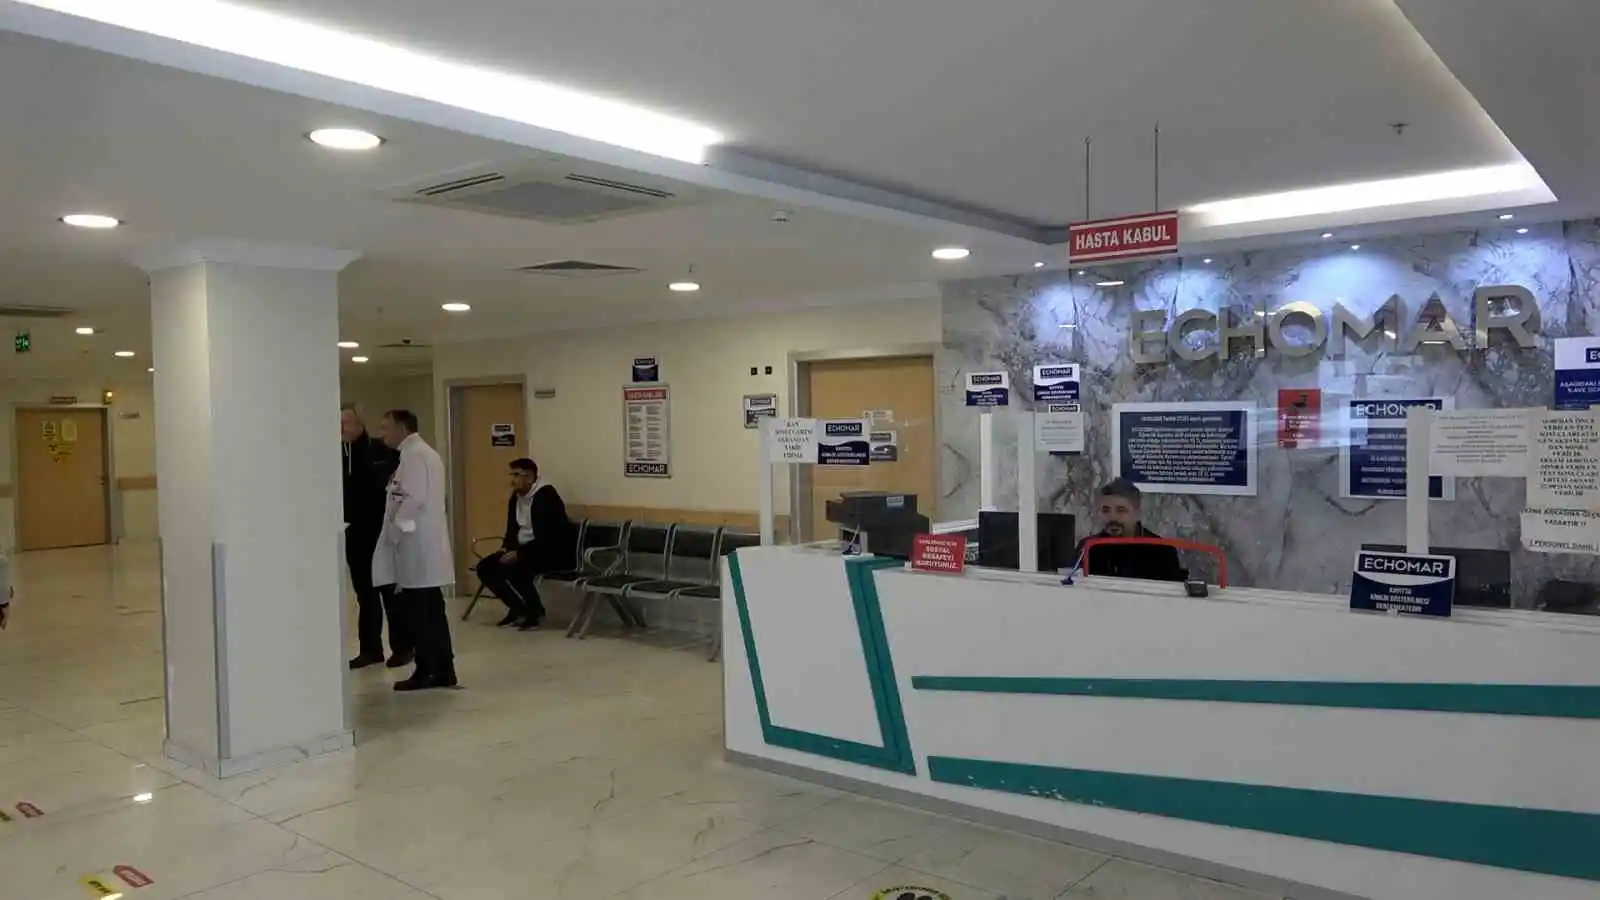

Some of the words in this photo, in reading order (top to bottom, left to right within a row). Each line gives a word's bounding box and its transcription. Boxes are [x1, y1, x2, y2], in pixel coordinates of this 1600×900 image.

[1076, 231, 1119, 250] HASTA
[1123, 225, 1171, 244] KABUL
[1131, 284, 1540, 364] ECHOMAR
[827, 422, 861, 432] ECHOMAR
[1364, 557, 1444, 574] ECHOMAR
